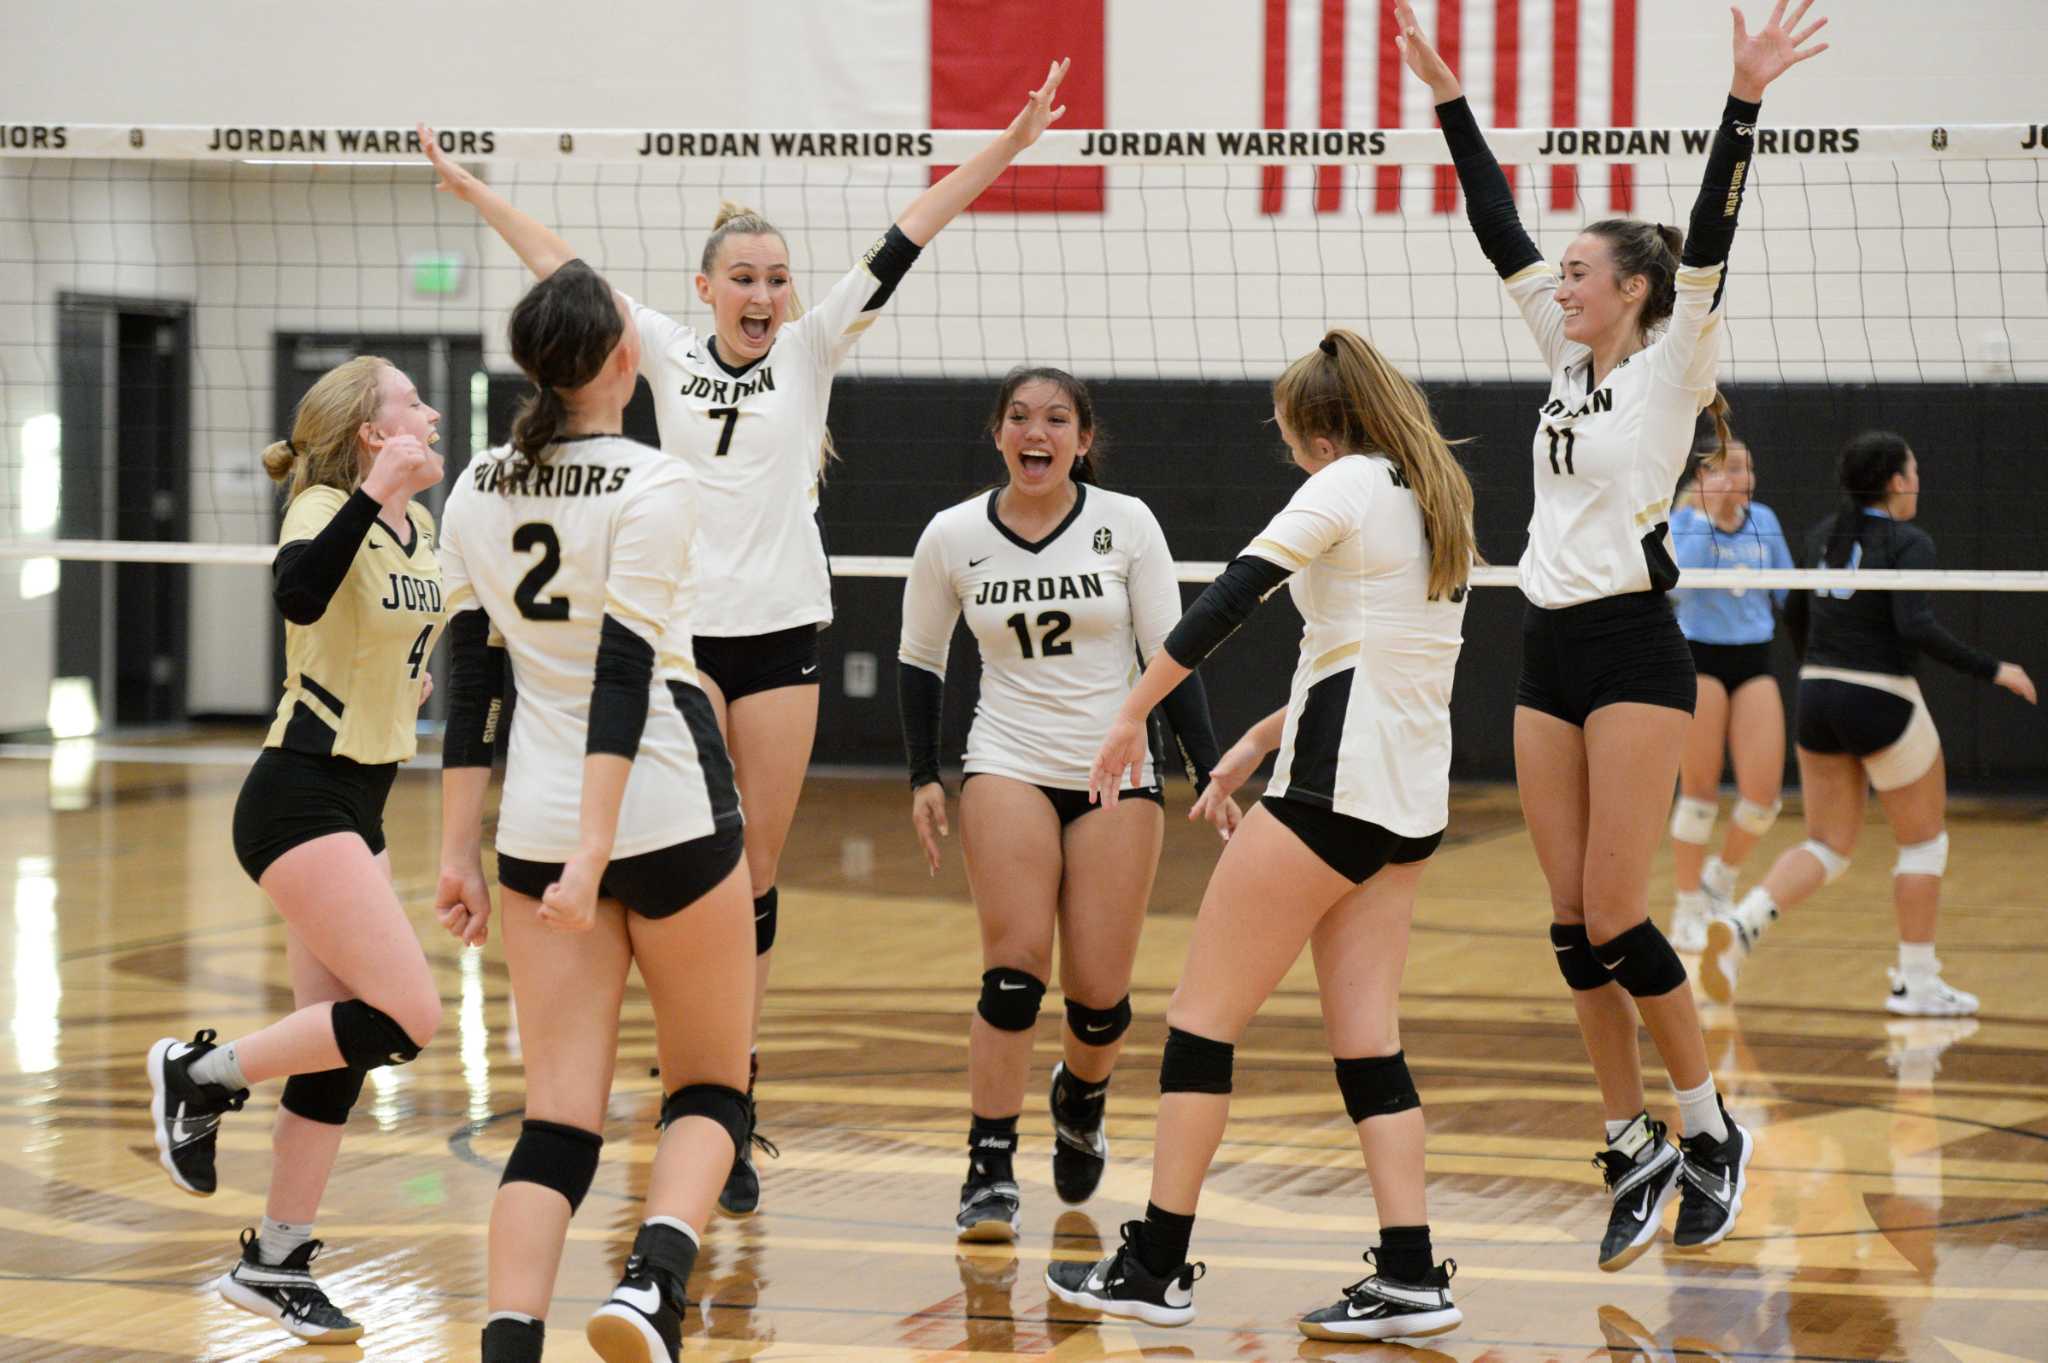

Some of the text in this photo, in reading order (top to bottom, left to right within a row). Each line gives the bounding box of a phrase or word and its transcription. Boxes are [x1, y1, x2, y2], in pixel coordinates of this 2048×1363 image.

[208, 128, 495, 153] JORDAN WARRORS
[640, 132, 933, 157] JORDAN WARRIORS
[1080, 131, 1386, 156] JORDAN WARRIORS
[1538, 130, 1670, 155] JORDAN
[1681, 128, 1860, 154] WRIORS
[681, 366, 775, 404] JORDAN
[708, 407, 739, 456] 7
[1545, 424, 1575, 475] 11
[474, 462, 632, 497] WARRIORS
[512, 522, 570, 622] 2
[975, 572, 1104, 605] JORDAN
[382, 573, 446, 613] JORD
[407, 624, 434, 679] 4
[1006, 610, 1073, 659] 12
